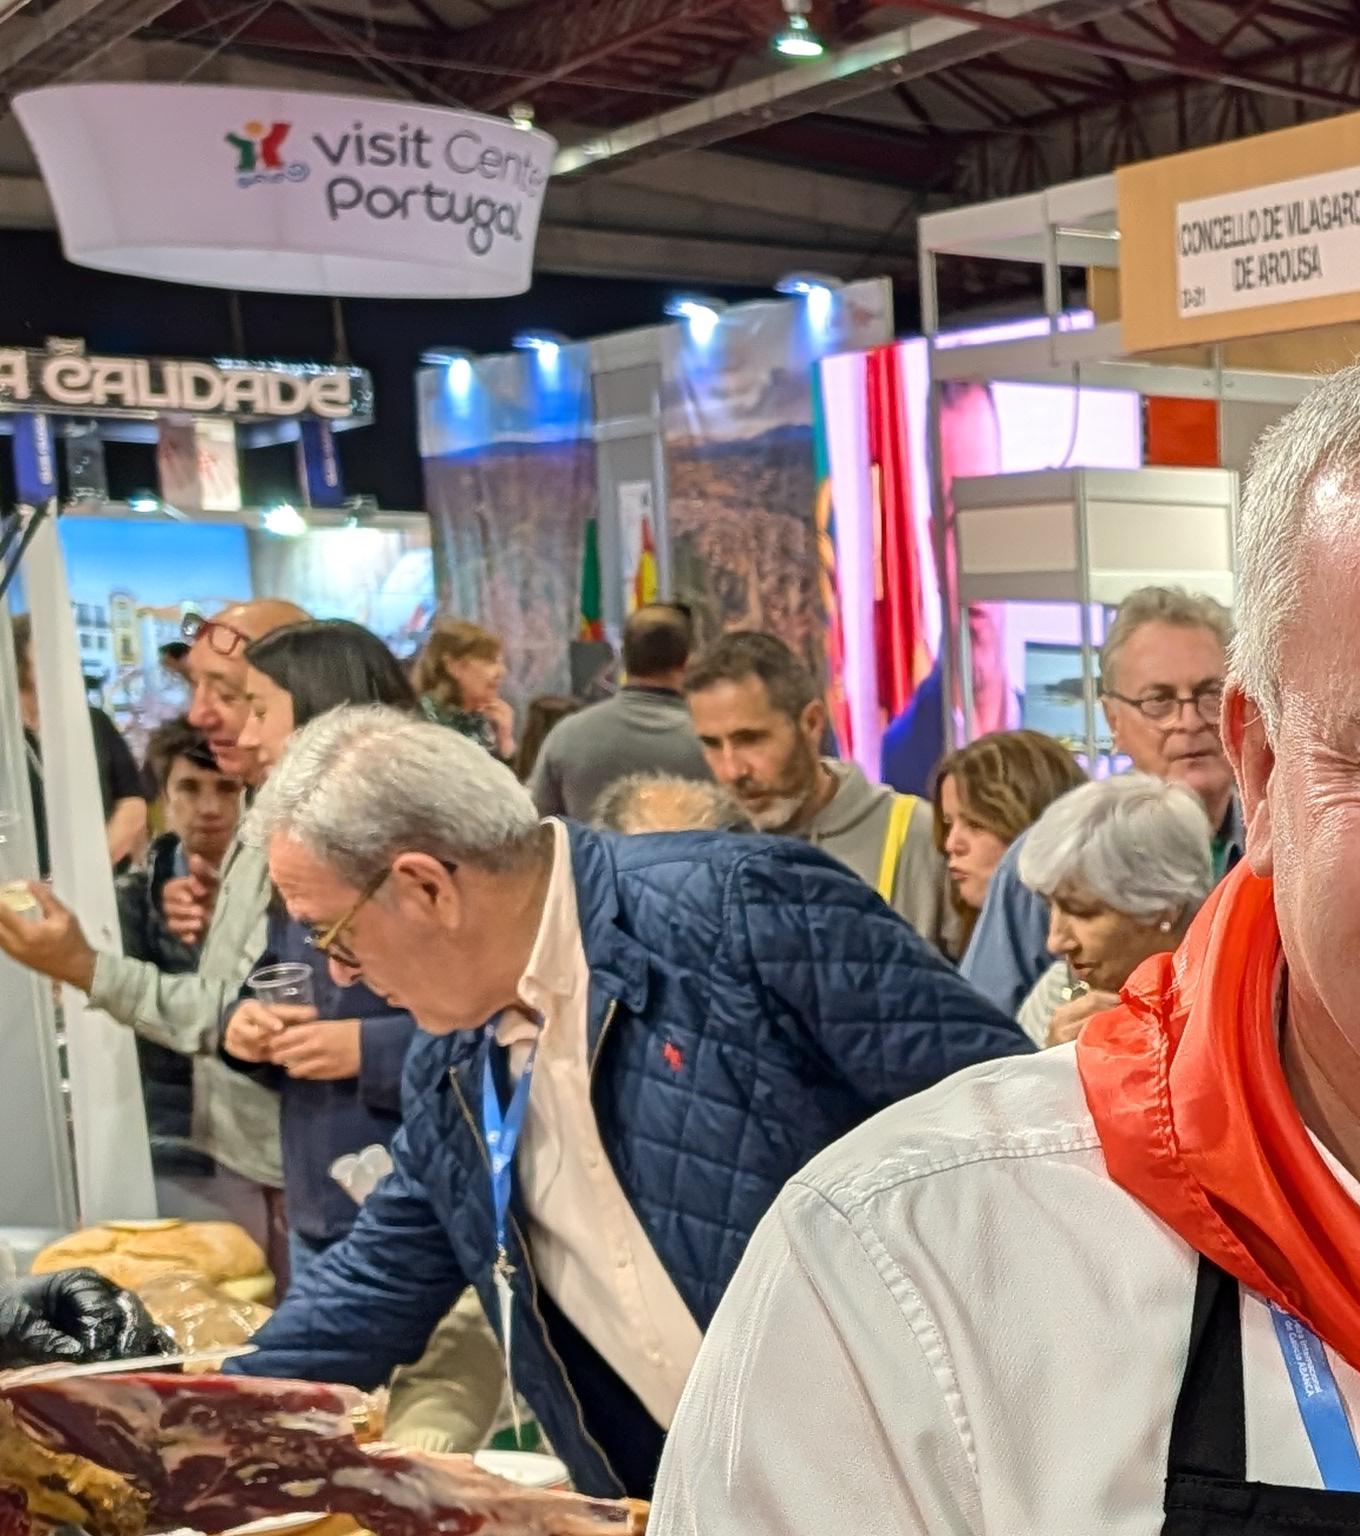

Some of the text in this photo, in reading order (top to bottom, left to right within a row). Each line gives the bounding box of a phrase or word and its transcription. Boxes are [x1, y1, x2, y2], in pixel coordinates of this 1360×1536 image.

[312, 121, 433, 170] visit
[1179, 209, 1261, 258] CONCELLO
[1262, 204, 1284, 243] DE
[1233, 244, 1324, 292] DE AROUSA
